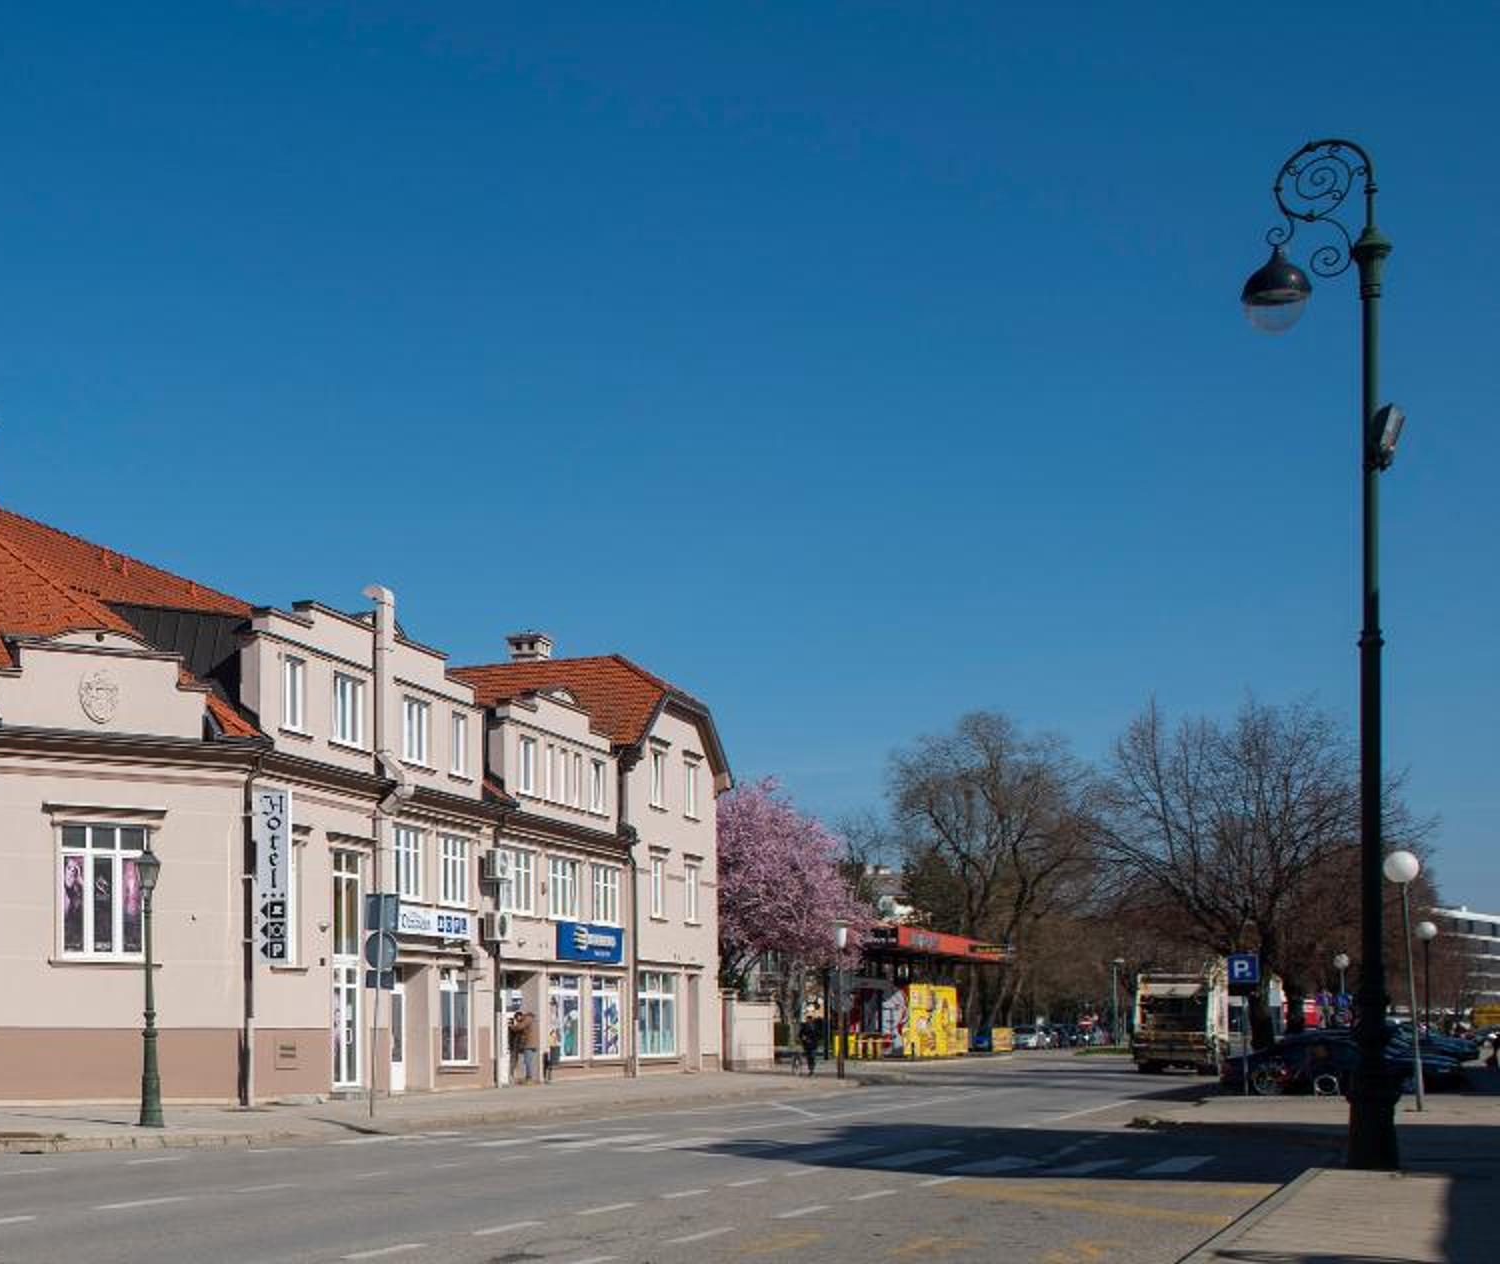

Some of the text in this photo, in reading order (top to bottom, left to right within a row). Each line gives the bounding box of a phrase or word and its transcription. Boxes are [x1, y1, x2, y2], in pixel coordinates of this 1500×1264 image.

[261, 795, 285, 888] Hotel
[272, 944, 283, 957] P
[1233, 960, 1249, 978] P
